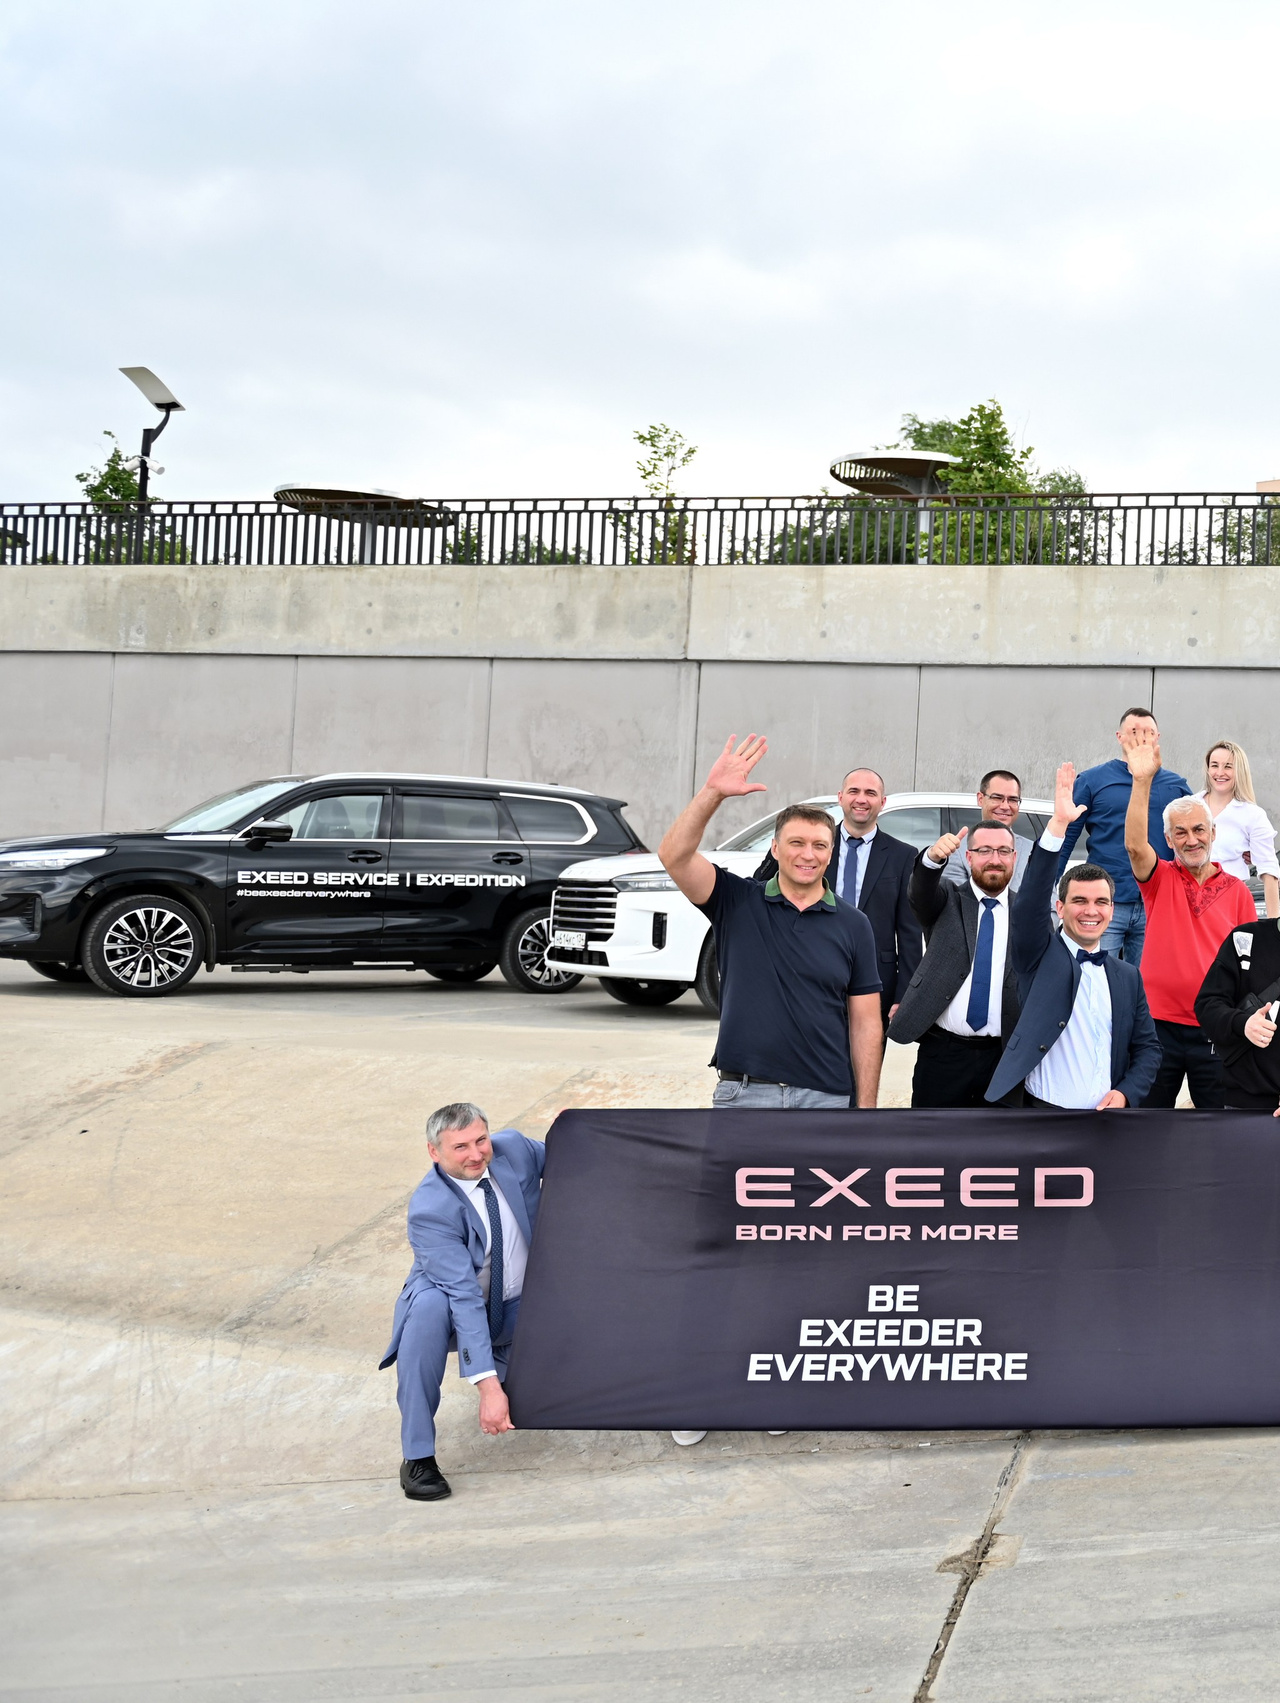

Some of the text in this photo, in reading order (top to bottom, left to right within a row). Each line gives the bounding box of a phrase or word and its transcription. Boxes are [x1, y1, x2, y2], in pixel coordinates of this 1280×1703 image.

[237, 870, 309, 885] EXEED
[313, 872, 400, 886] SERVICE
[416, 873, 526, 887] EXPEDITION
[735, 1167, 1094, 1207] EXEED
[736, 1225, 1019, 1241] BORN FOR MORE
[868, 1285, 919, 1312] BE
[799, 1318, 983, 1347] EXEEDER
[747, 1353, 1028, 1381] EVERYWHERE
